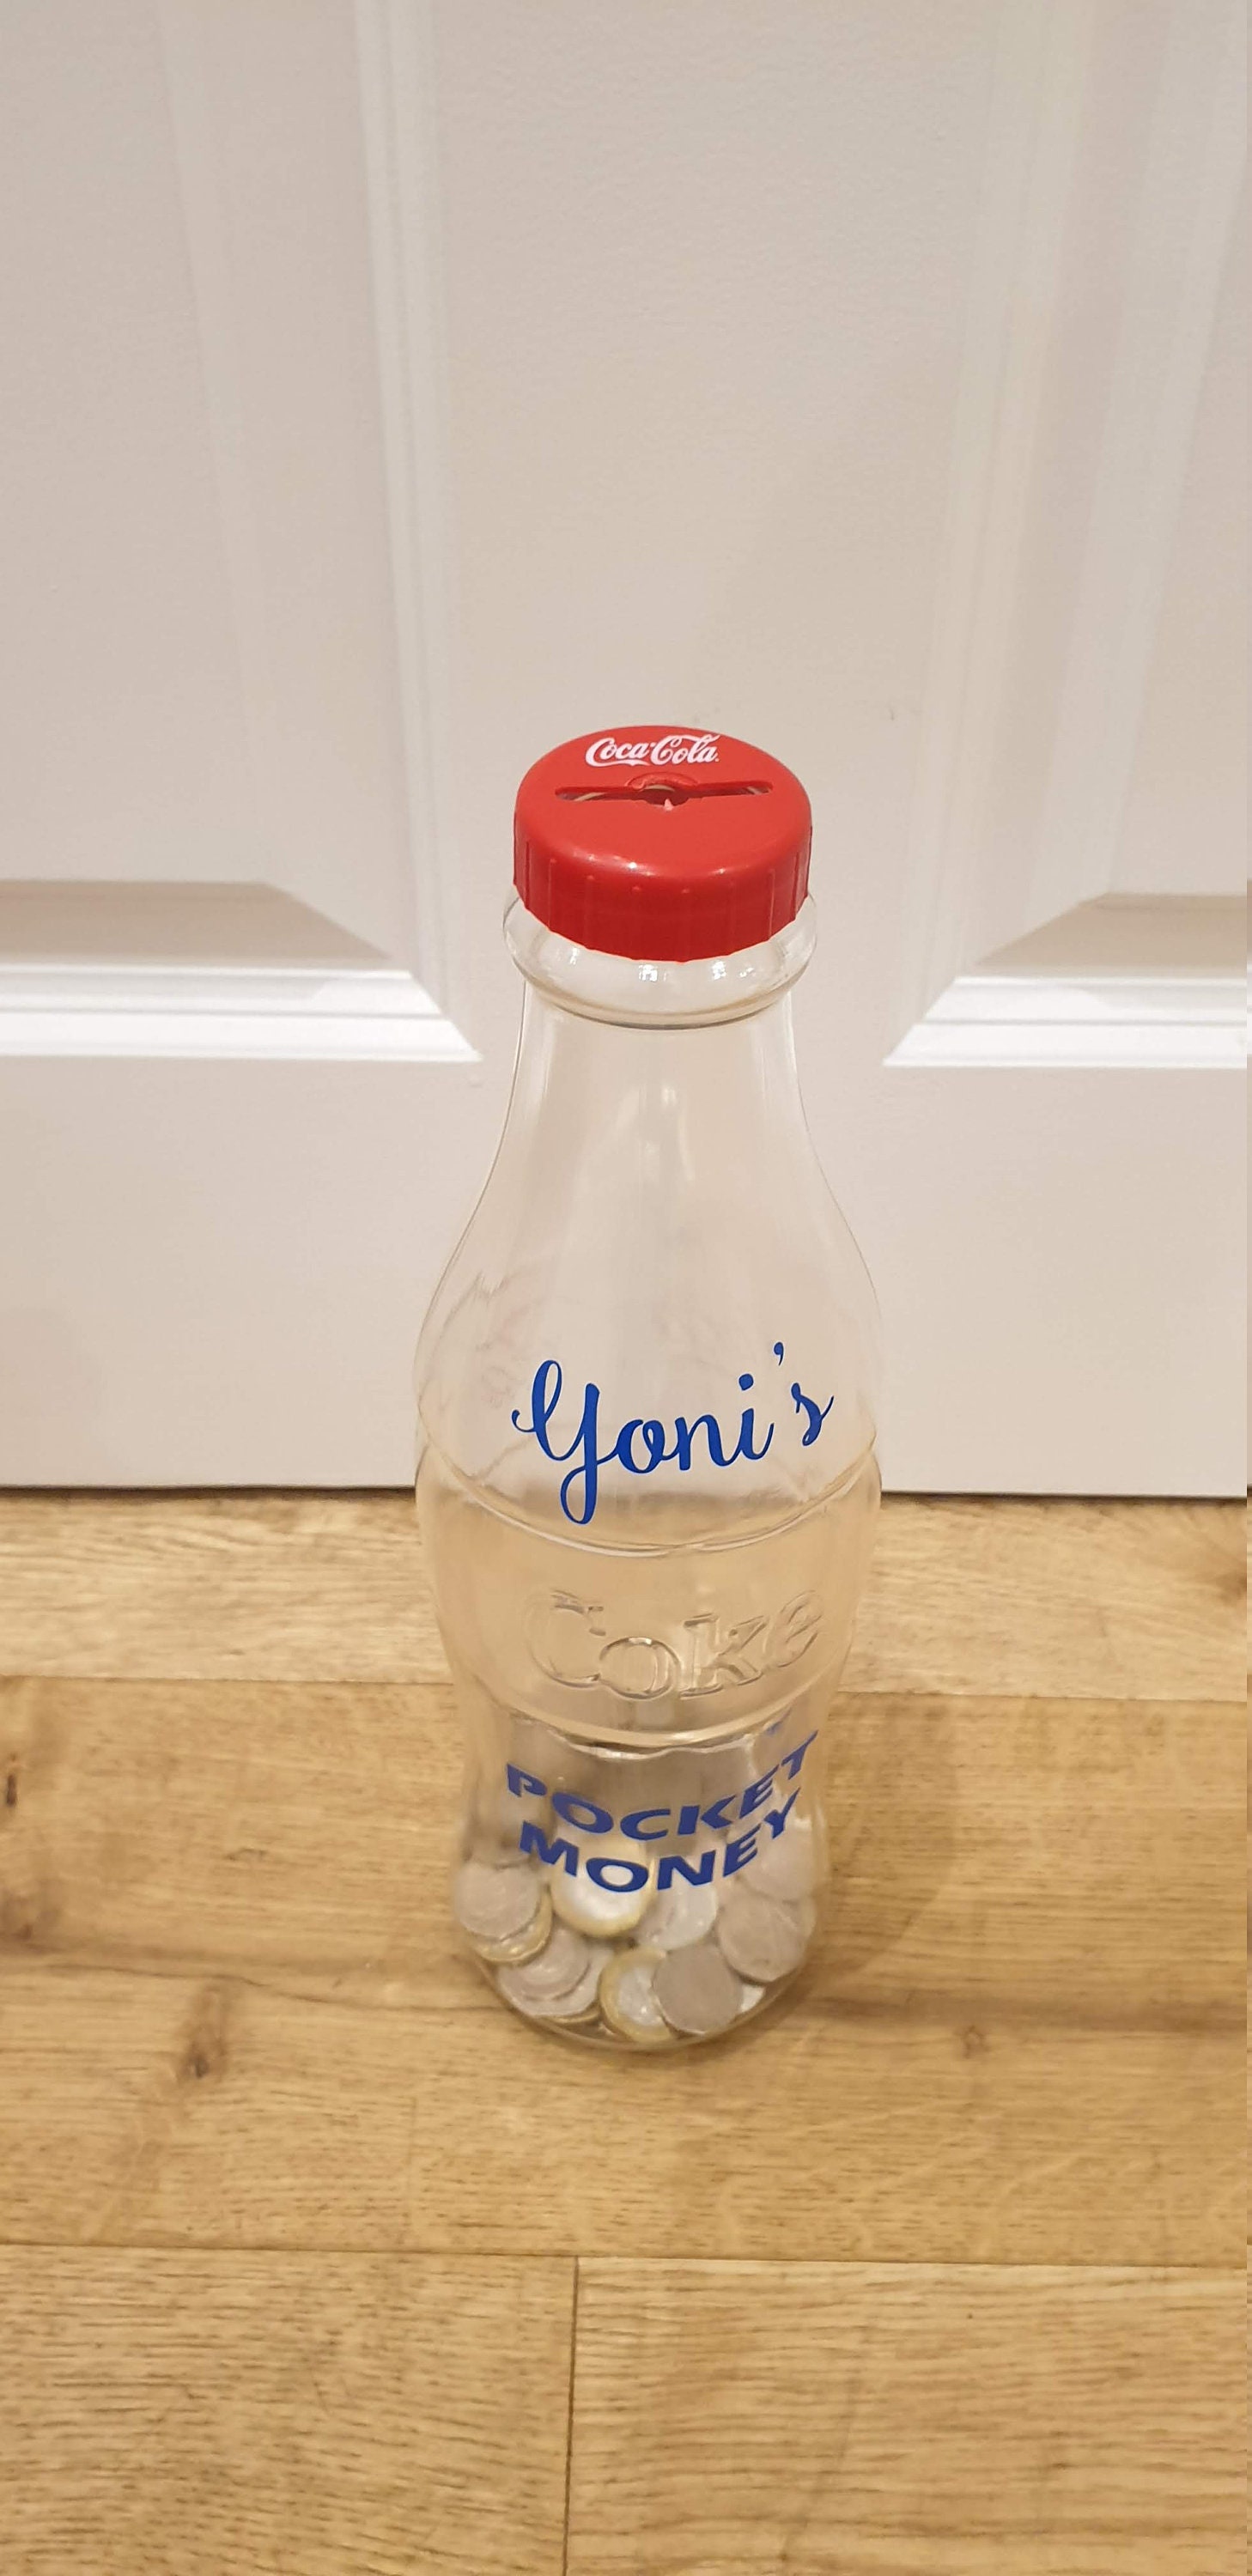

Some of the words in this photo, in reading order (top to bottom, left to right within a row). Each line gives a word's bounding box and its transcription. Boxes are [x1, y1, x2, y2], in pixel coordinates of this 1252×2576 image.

[586, 734, 720, 767] Coca-Cola
[511, 1341, 834, 1525] Yoni's
[524, 1589, 824, 1701] Coke
[506, 1729, 819, 1840] POCKET
[519, 1787, 800, 1893] MONEY
